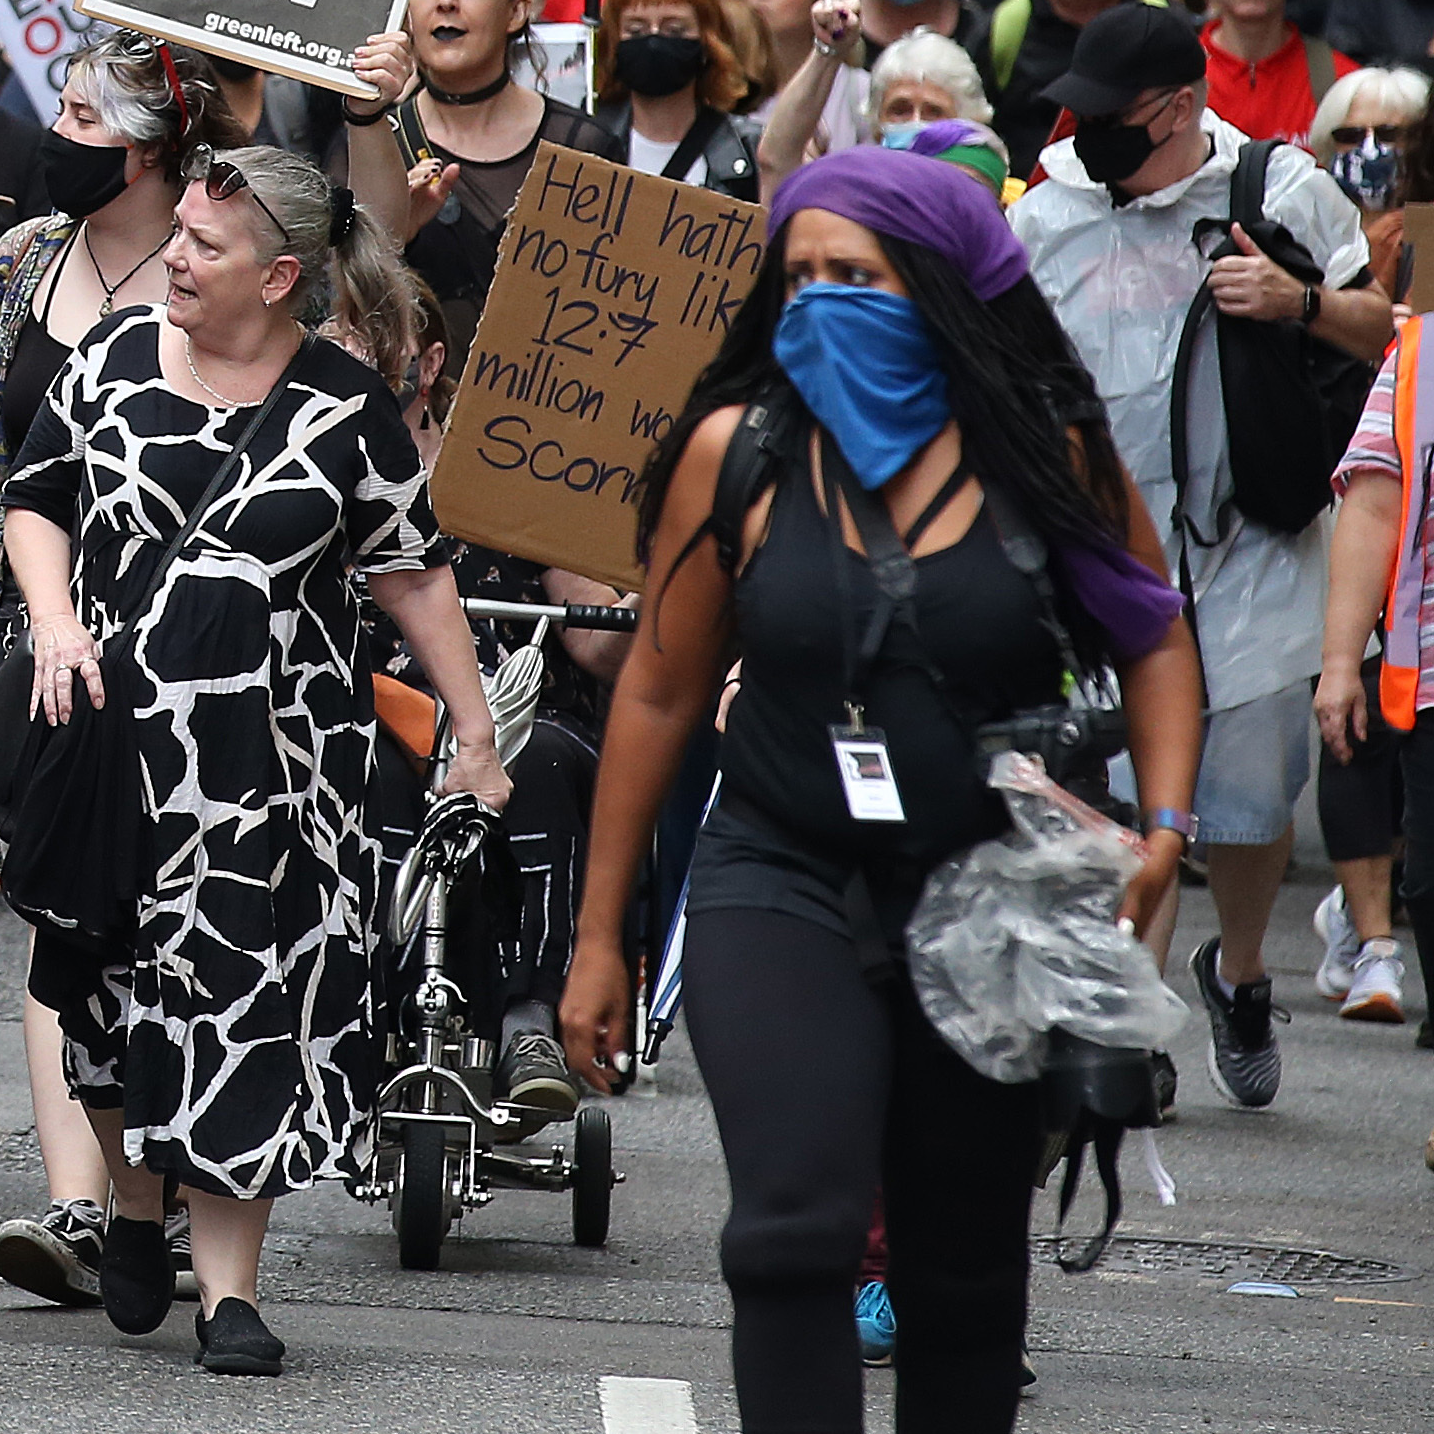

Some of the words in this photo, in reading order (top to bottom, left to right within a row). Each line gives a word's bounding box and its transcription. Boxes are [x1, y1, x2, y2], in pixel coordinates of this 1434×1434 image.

[537, 153, 635, 237] Hell
[658, 188, 763, 275] hath
[512, 225, 569, 277] no
[577, 232, 660, 318] fury
[680, 271, 744, 339] lik
[473, 351, 605, 423] million
